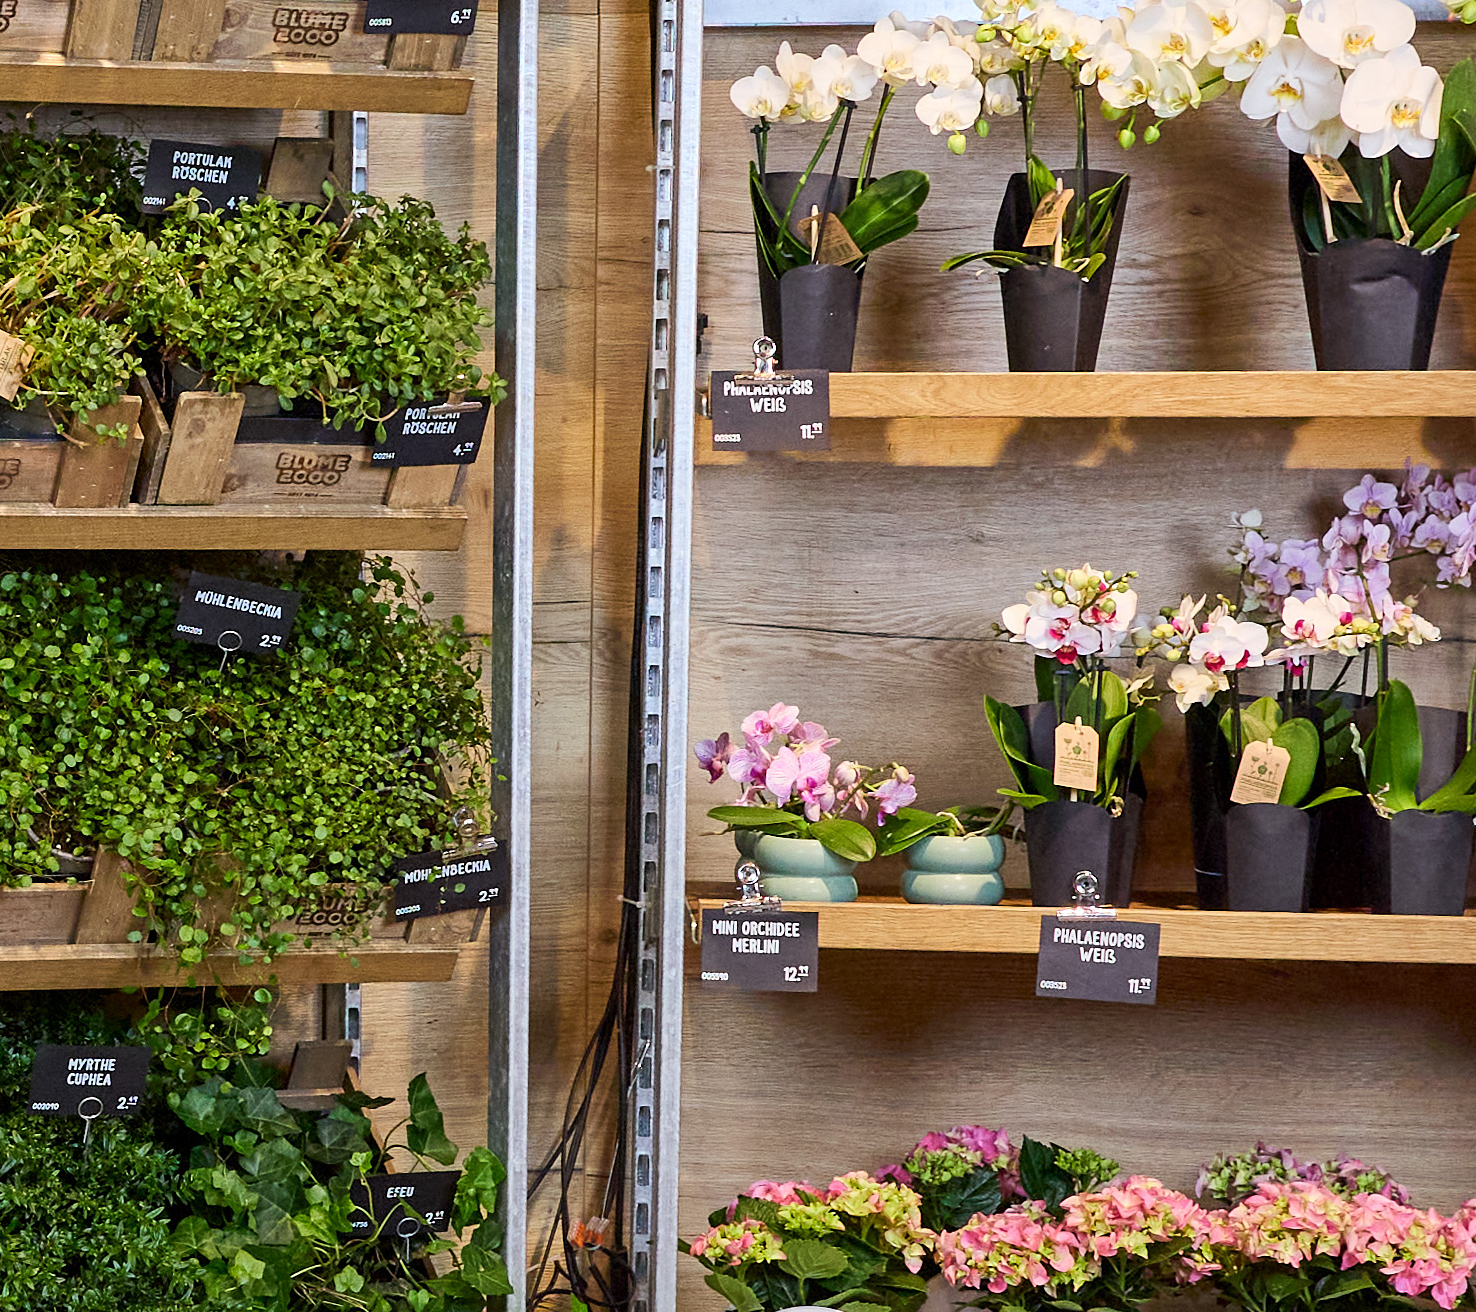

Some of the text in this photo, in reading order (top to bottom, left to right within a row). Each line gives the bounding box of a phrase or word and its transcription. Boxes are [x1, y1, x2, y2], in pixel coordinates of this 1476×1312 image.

[172, 151, 233, 169] PORTULAK
[172, 166, 229, 184] RÖSCHEN
[402, 421, 457, 436] RÖSCHEN
[194, 590, 282, 619] MÜHLENBECKIA
[712, 920, 800, 938] MINI ORCHIDEE
[731, 937, 780, 954] MERLINI
[1053, 928, 1145, 949] PHALAENOPSIS
[67, 1058, 116, 1072] MYRTHE
[66, 1072, 112, 1086] CUPHEA
[386, 1187, 415, 1198] EFEU
